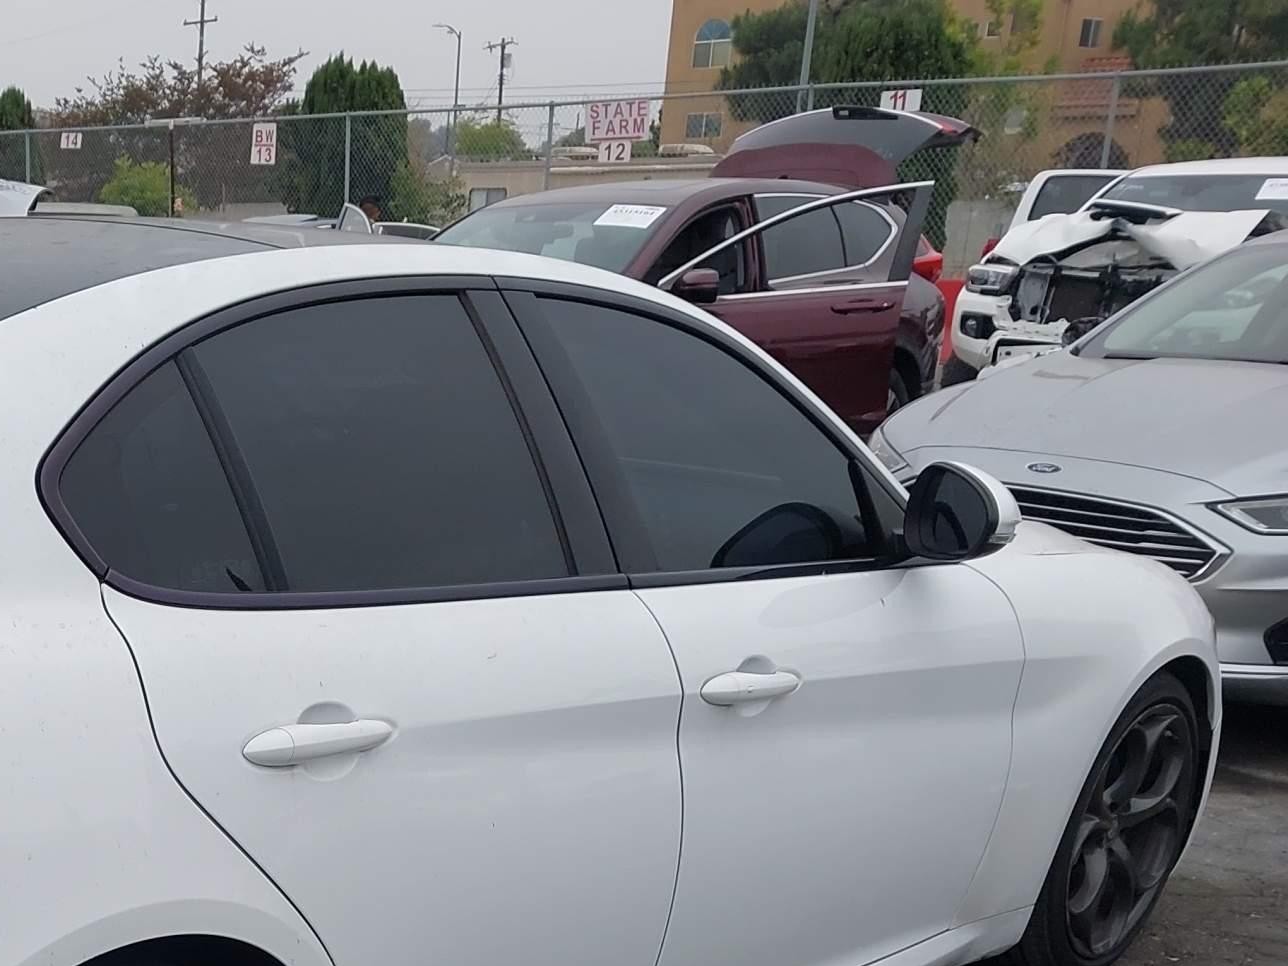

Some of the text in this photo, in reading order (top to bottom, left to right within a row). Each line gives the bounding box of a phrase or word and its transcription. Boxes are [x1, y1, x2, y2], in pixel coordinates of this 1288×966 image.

[590, 100, 647, 119] STATE
[890, 90, 907, 111] 11
[255, 129, 274, 143] BW
[592, 118, 645, 136] FARM
[65, 134, 78, 146] 14
[257, 147, 272, 162] 13
[604, 143, 626, 161] 12
